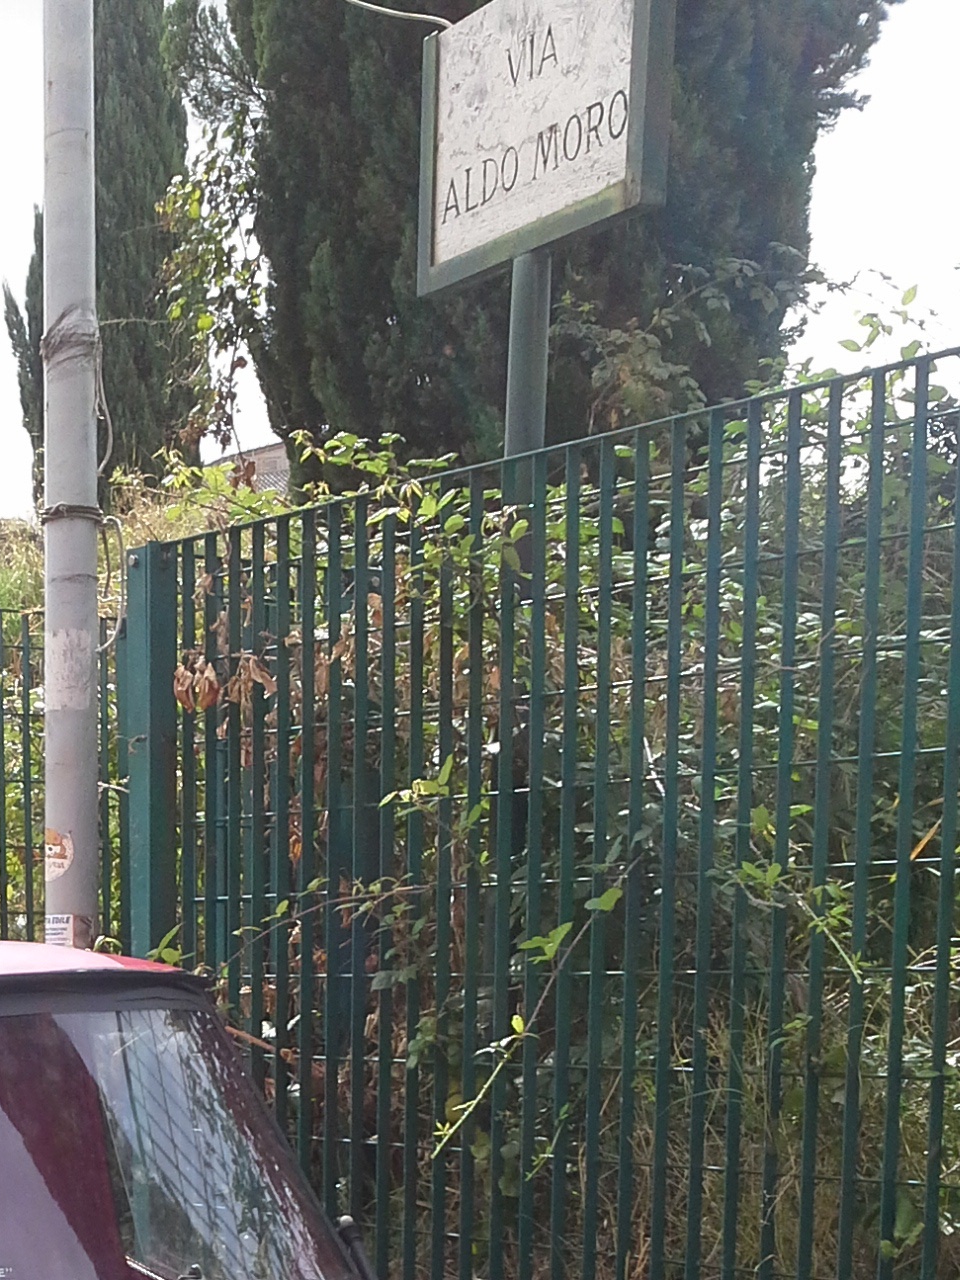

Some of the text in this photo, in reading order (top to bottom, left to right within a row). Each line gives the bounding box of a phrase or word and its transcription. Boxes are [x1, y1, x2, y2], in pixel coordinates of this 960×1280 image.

[506, 23, 559, 88] VIA
[441, 89, 629, 225] ALDO MORO
